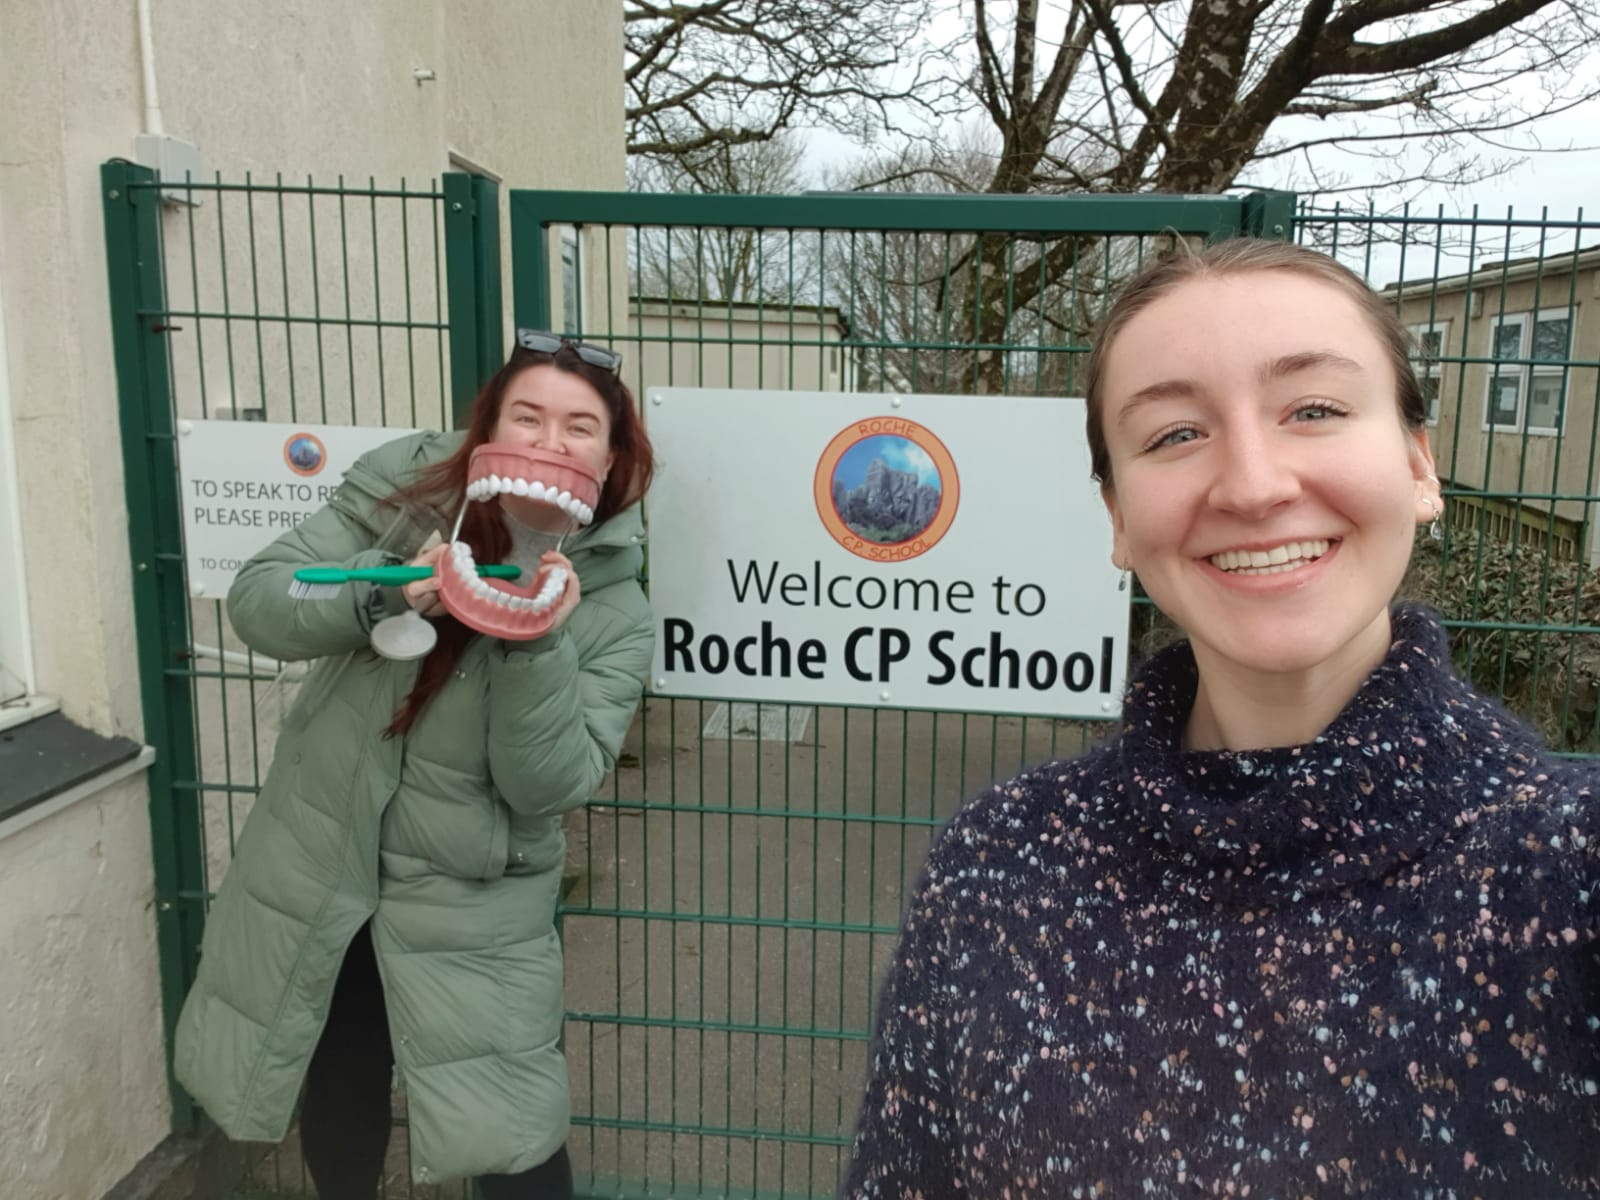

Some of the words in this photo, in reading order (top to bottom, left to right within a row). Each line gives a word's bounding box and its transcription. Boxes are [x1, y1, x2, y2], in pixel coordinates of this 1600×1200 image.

[858, 420, 915, 438] ROCHE
[192, 479, 218, 498] TO
[223, 481, 283, 500] SPEAK
[285, 483, 312, 502] TO
[194, 507, 262, 527] PLEASE
[868, 538, 932, 560] SCHOOL
[200, 557, 217, 570] TO
[727, 558, 975, 614] Welcome
[991, 575, 1046, 617] to
[663, 617, 827, 680] Roche
[844, 626, 911, 683] CP
[927, 630, 1114, 694] School
